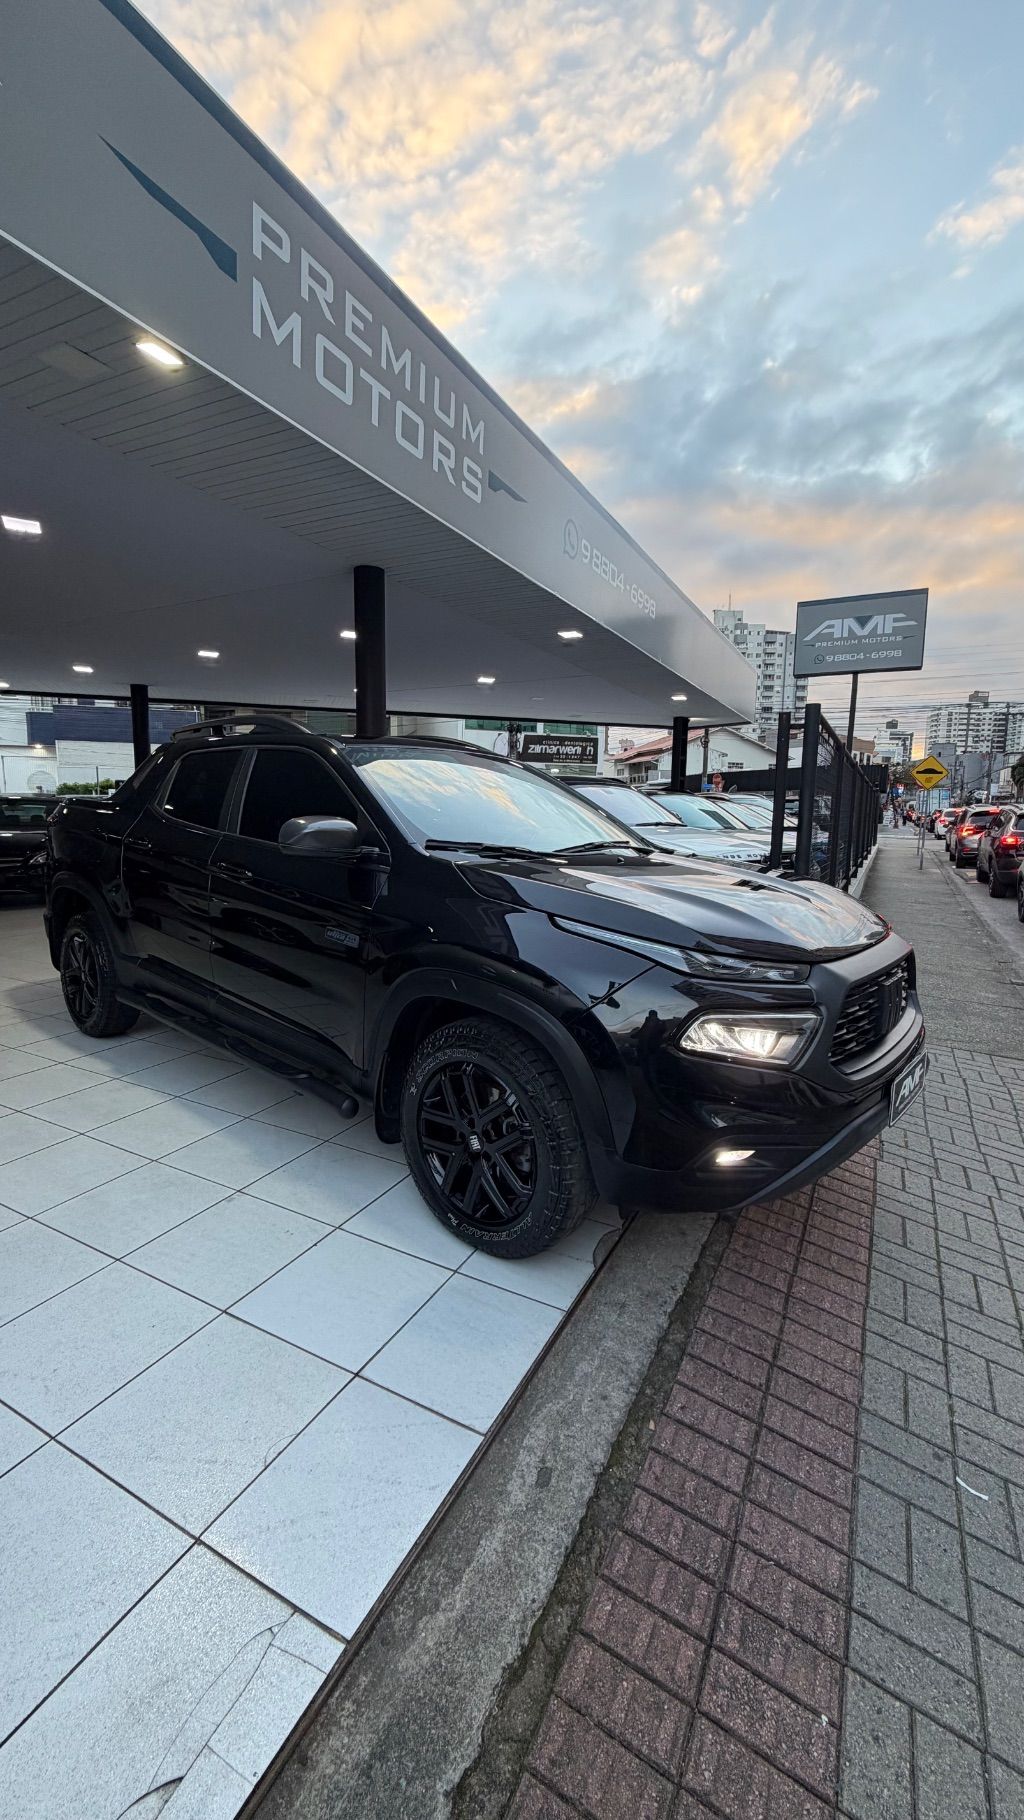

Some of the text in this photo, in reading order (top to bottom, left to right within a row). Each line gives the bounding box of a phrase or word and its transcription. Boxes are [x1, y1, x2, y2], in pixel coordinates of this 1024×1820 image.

[252, 200, 485, 456] PREMIUM
[252, 276, 482, 504] MOTORS
[803, 613, 918, 640] AMF
[815, 635, 903, 648] PREMIUM MOTORS
[895, 1063, 924, 1107] AMF
